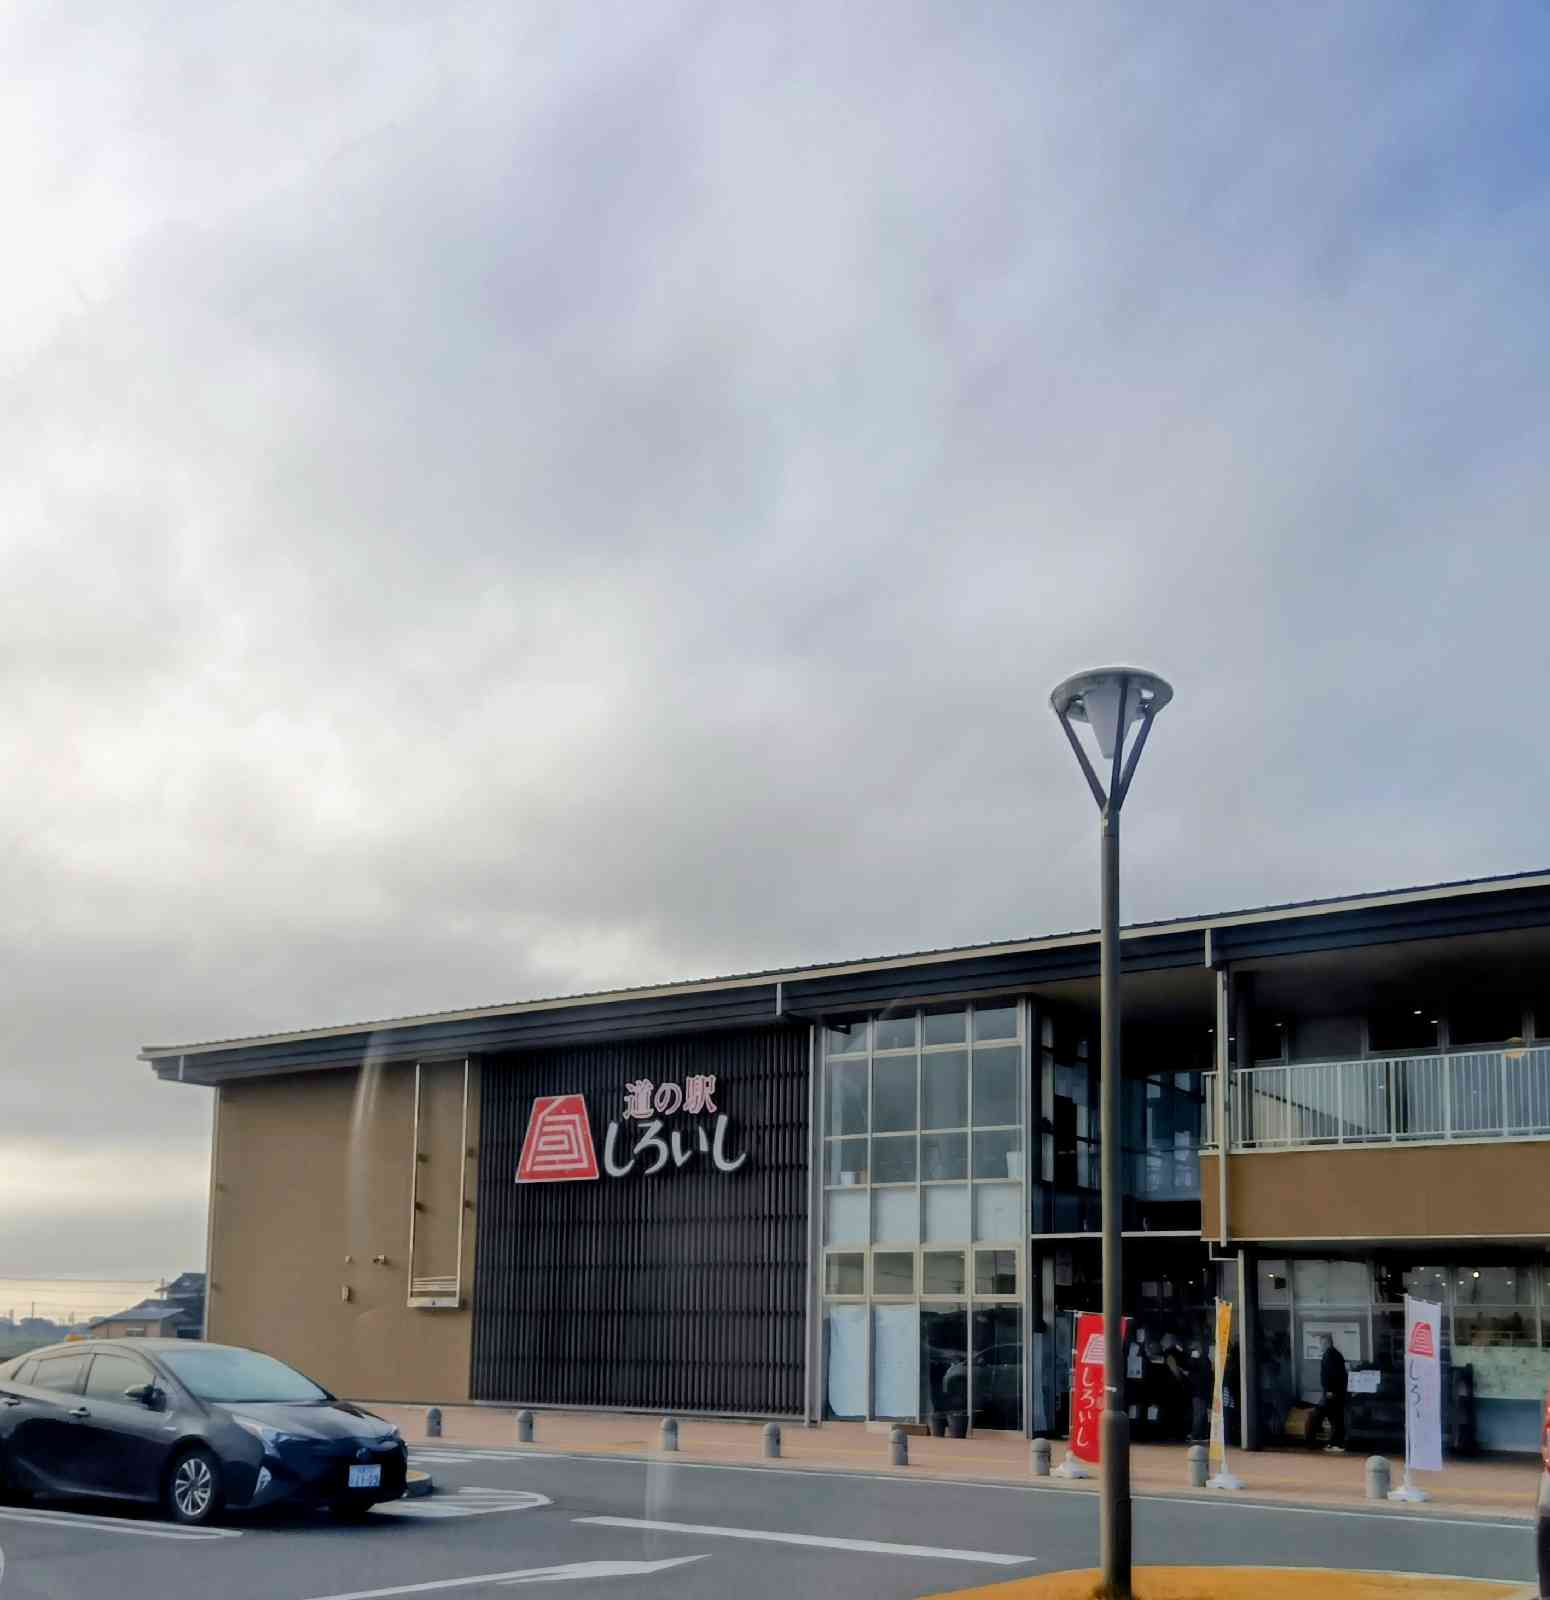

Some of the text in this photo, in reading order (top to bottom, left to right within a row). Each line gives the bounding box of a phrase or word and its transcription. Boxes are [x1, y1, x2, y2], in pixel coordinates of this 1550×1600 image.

[623, 1075, 717, 1119] 道の駅
[604, 1115, 746, 1177] しろいし
[1076, 1366, 1095, 1447] しろいし
